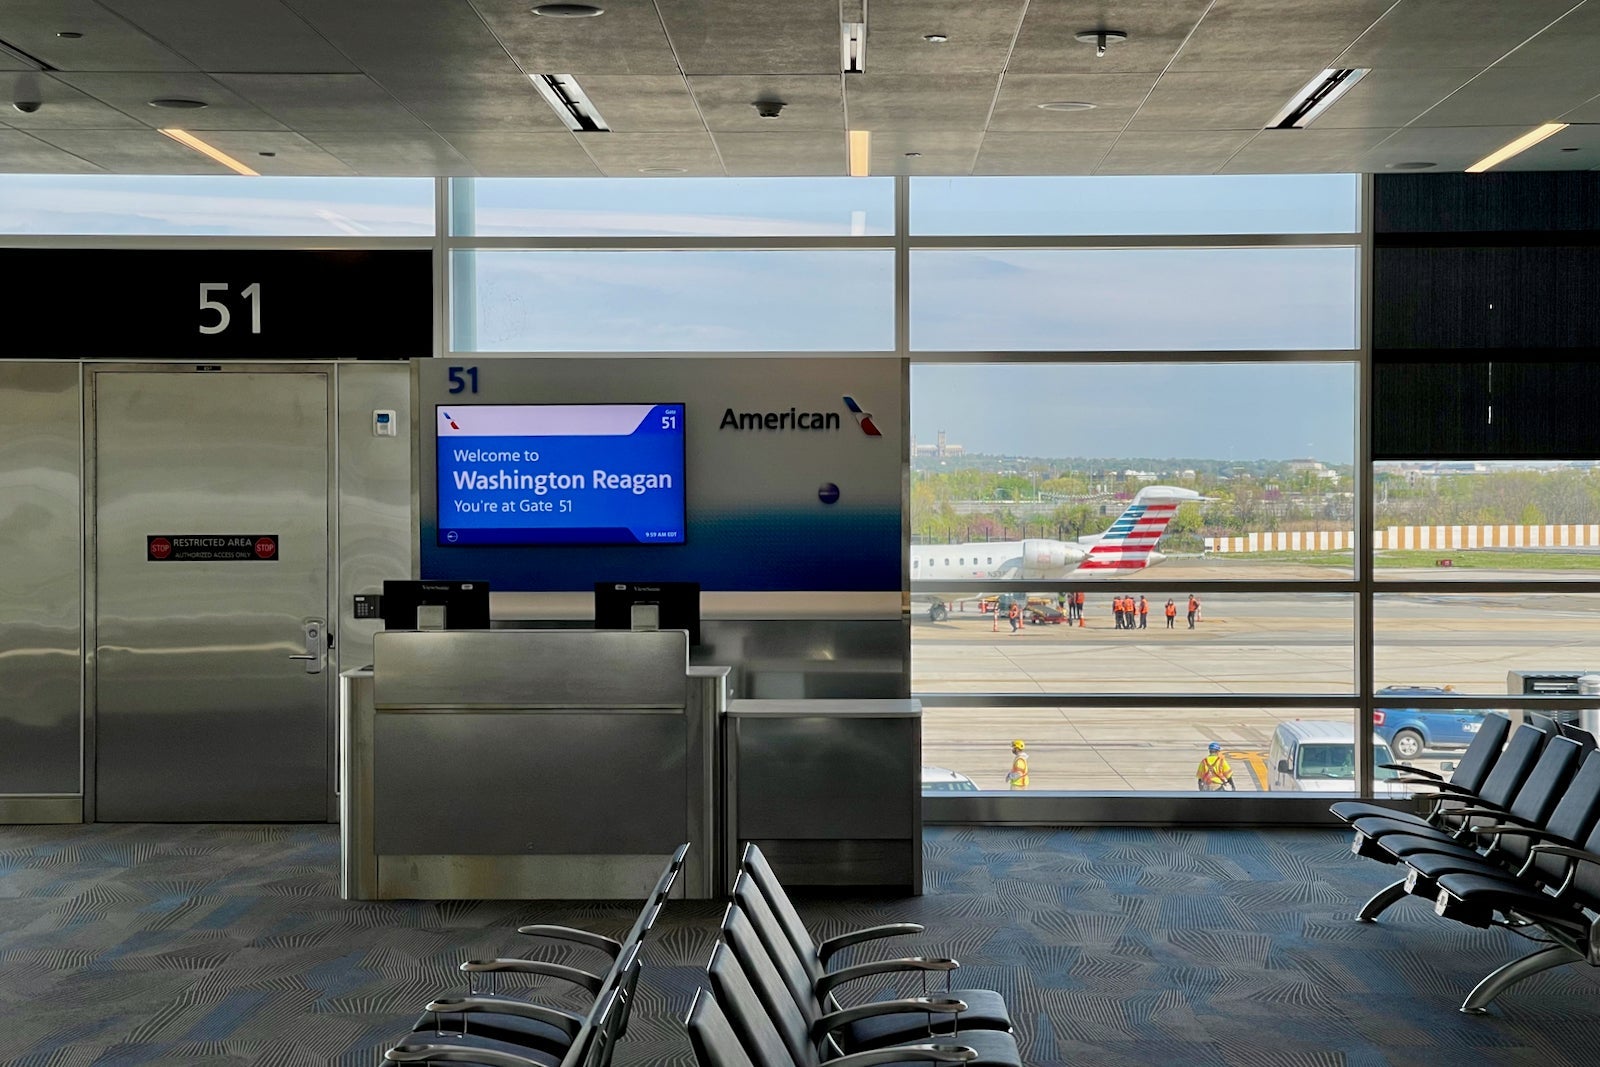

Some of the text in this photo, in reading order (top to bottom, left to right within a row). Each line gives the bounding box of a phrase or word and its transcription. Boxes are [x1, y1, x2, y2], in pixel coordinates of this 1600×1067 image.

[199, 283, 261, 335] 51
[447, 366, 479, 394] 51
[662, 416, 676, 429] 51
[720, 408, 840, 430] American
[453, 449, 540, 462] Welcome to
[453, 469, 673, 495] Washington Reagan
[454, 500, 573, 512] You're at Gate 51
[151, 544, 170, 553] STOP
[173, 538, 252, 547] RESTRICTED AREA
[256, 543, 274, 552] STOP
[175, 551, 212, 559] AUTHORIZED
[213, 551, 235, 559] ACCESS
